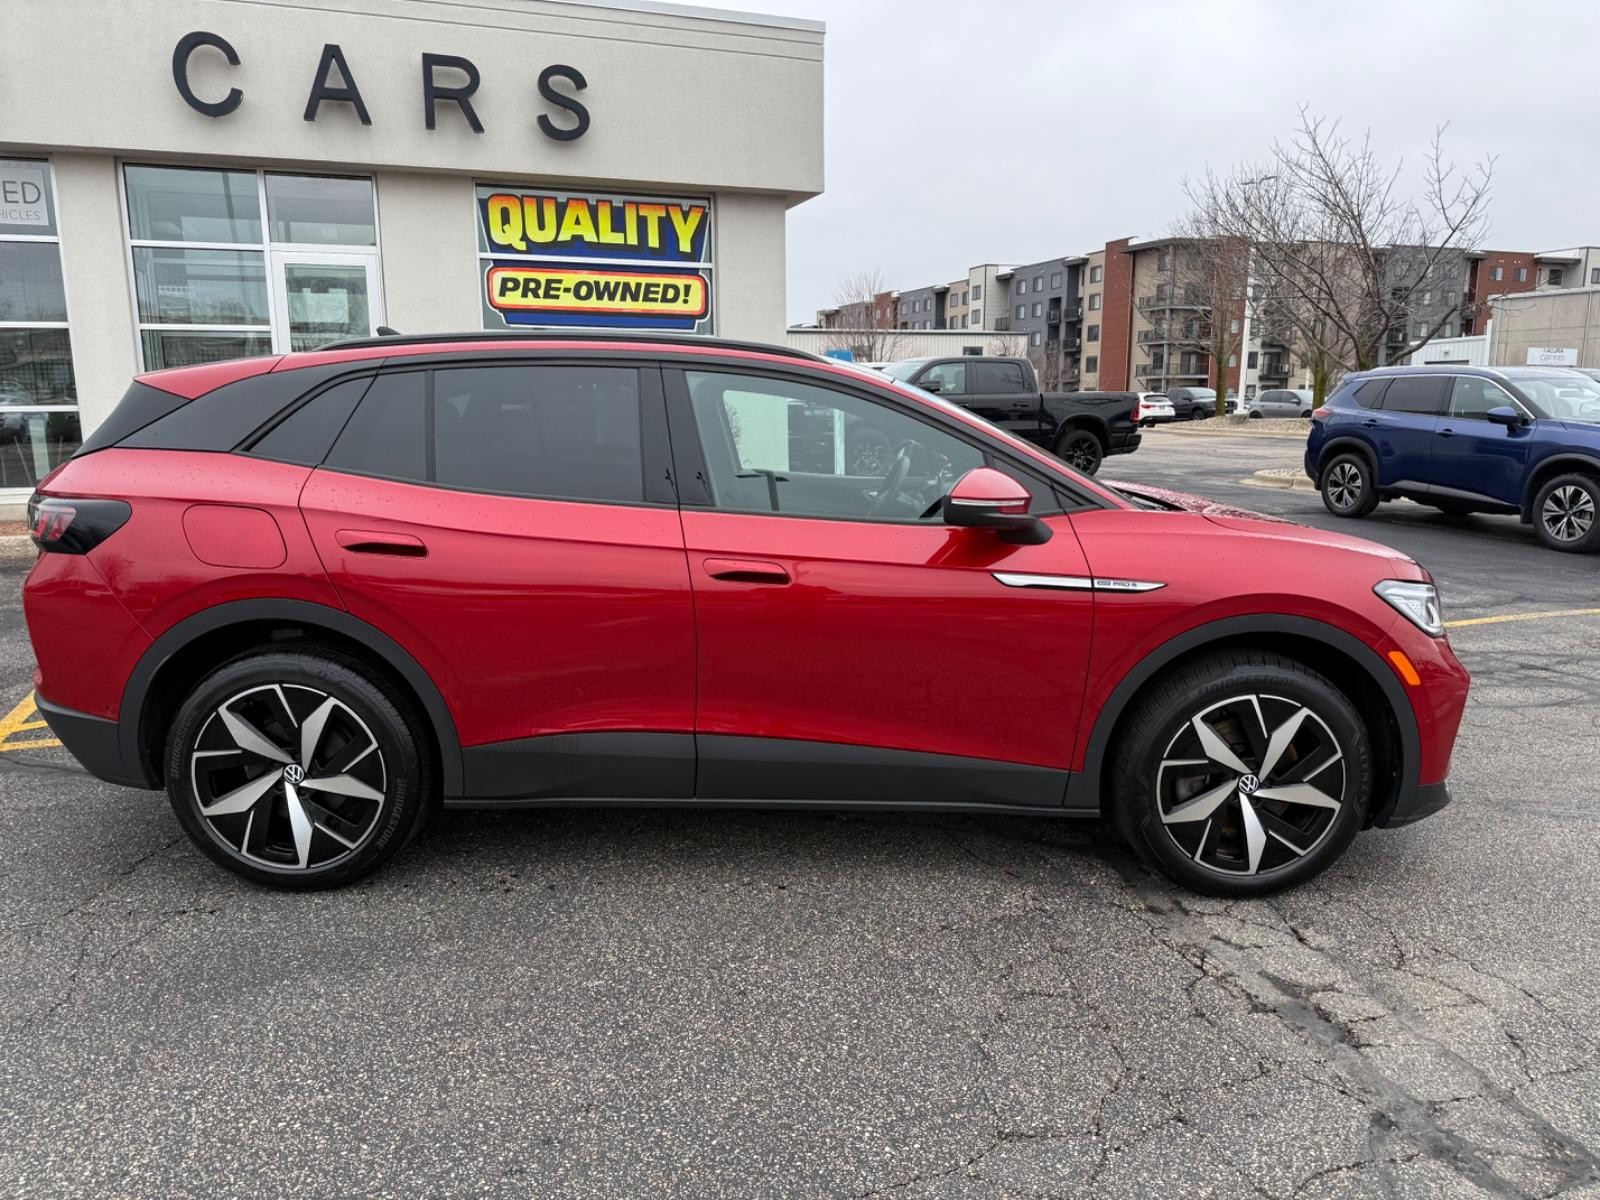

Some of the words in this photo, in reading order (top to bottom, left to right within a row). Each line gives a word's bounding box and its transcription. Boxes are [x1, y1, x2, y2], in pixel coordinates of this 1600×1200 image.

[172, 31, 590, 142] CARS
[487, 193, 704, 253] QUALITY
[498, 277, 692, 305] PRE-OWNED!
